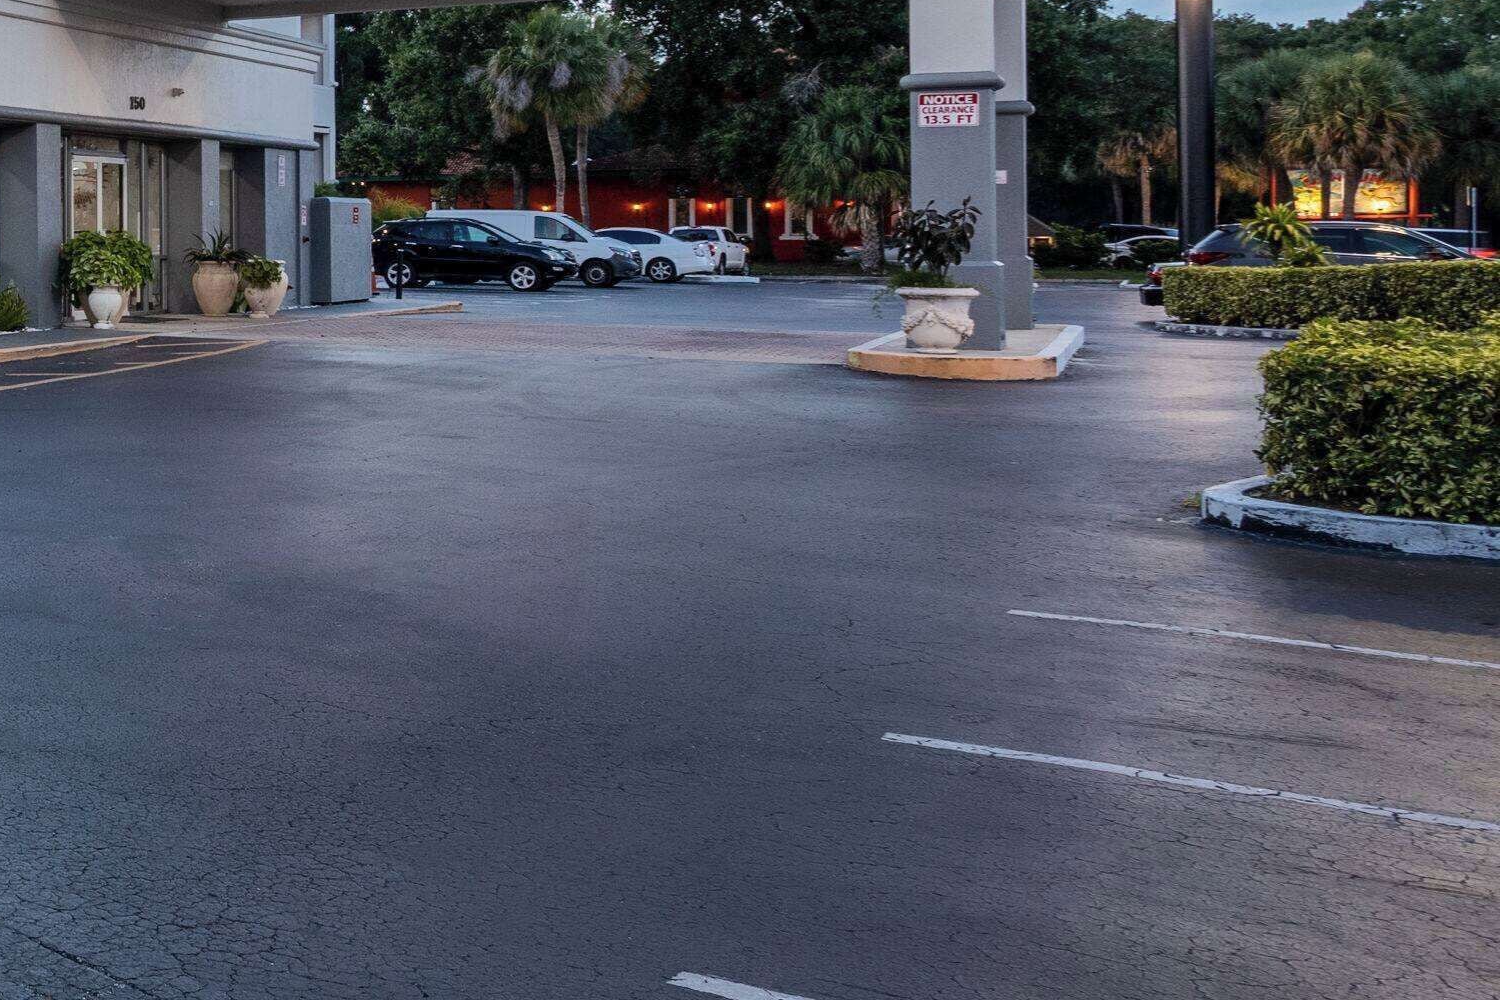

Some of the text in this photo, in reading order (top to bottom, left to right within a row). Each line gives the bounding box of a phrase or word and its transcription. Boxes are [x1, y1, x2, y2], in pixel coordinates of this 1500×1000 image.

[129, 96, 146, 110] 150
[923, 94, 974, 105] NOTICE
[922, 106, 975, 114] CLEARANCE
[924, 115, 973, 124] 13.5 FT
